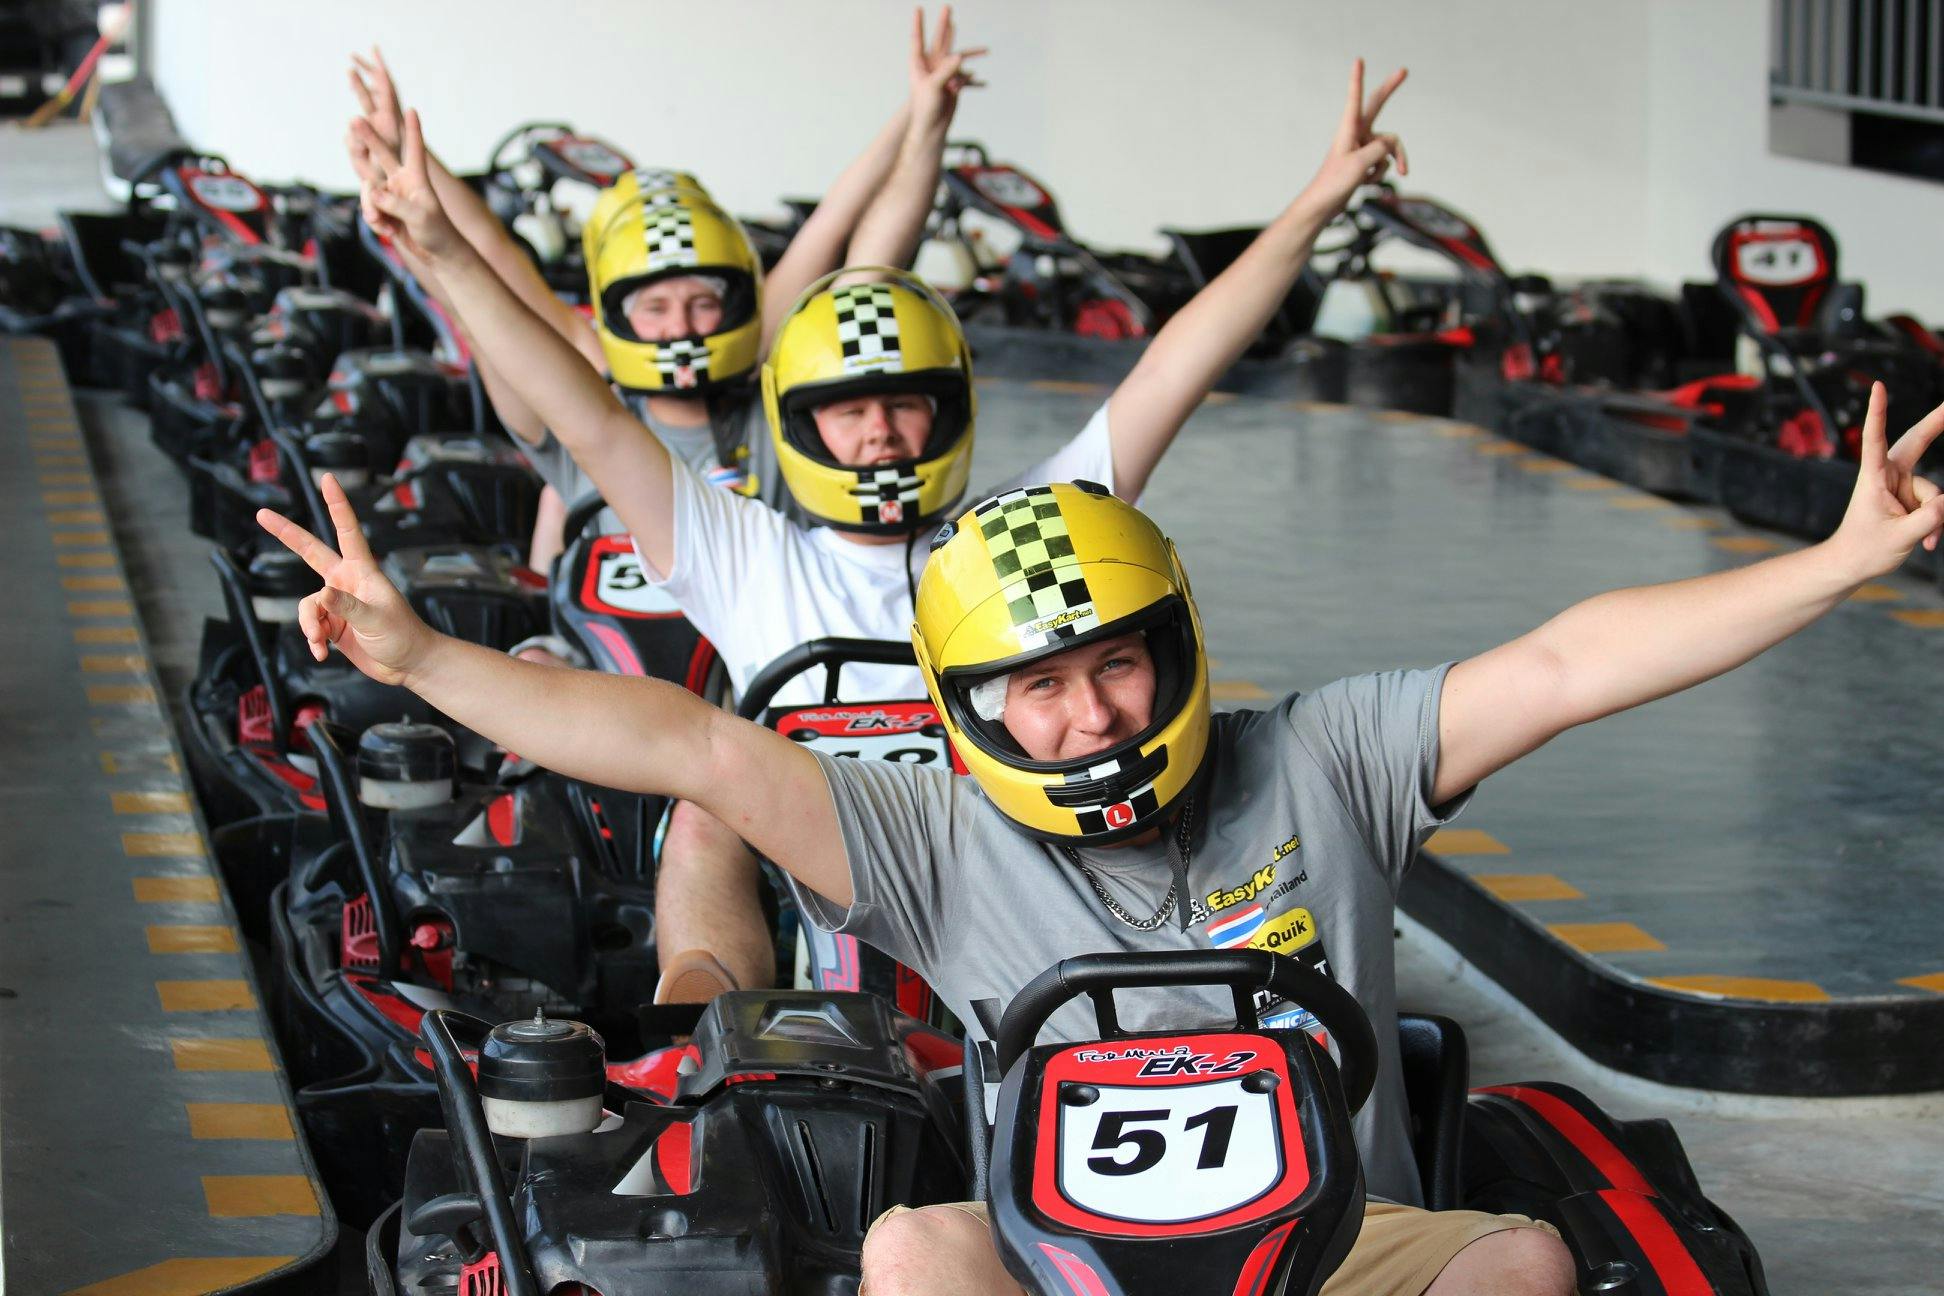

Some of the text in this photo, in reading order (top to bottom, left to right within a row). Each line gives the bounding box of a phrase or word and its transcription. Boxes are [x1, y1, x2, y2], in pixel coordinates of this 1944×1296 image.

[1248, 920, 1308, 949] -Quik
[1136, 1051, 1257, 1078] EK-2
[1086, 1105, 1239, 1176] 51
